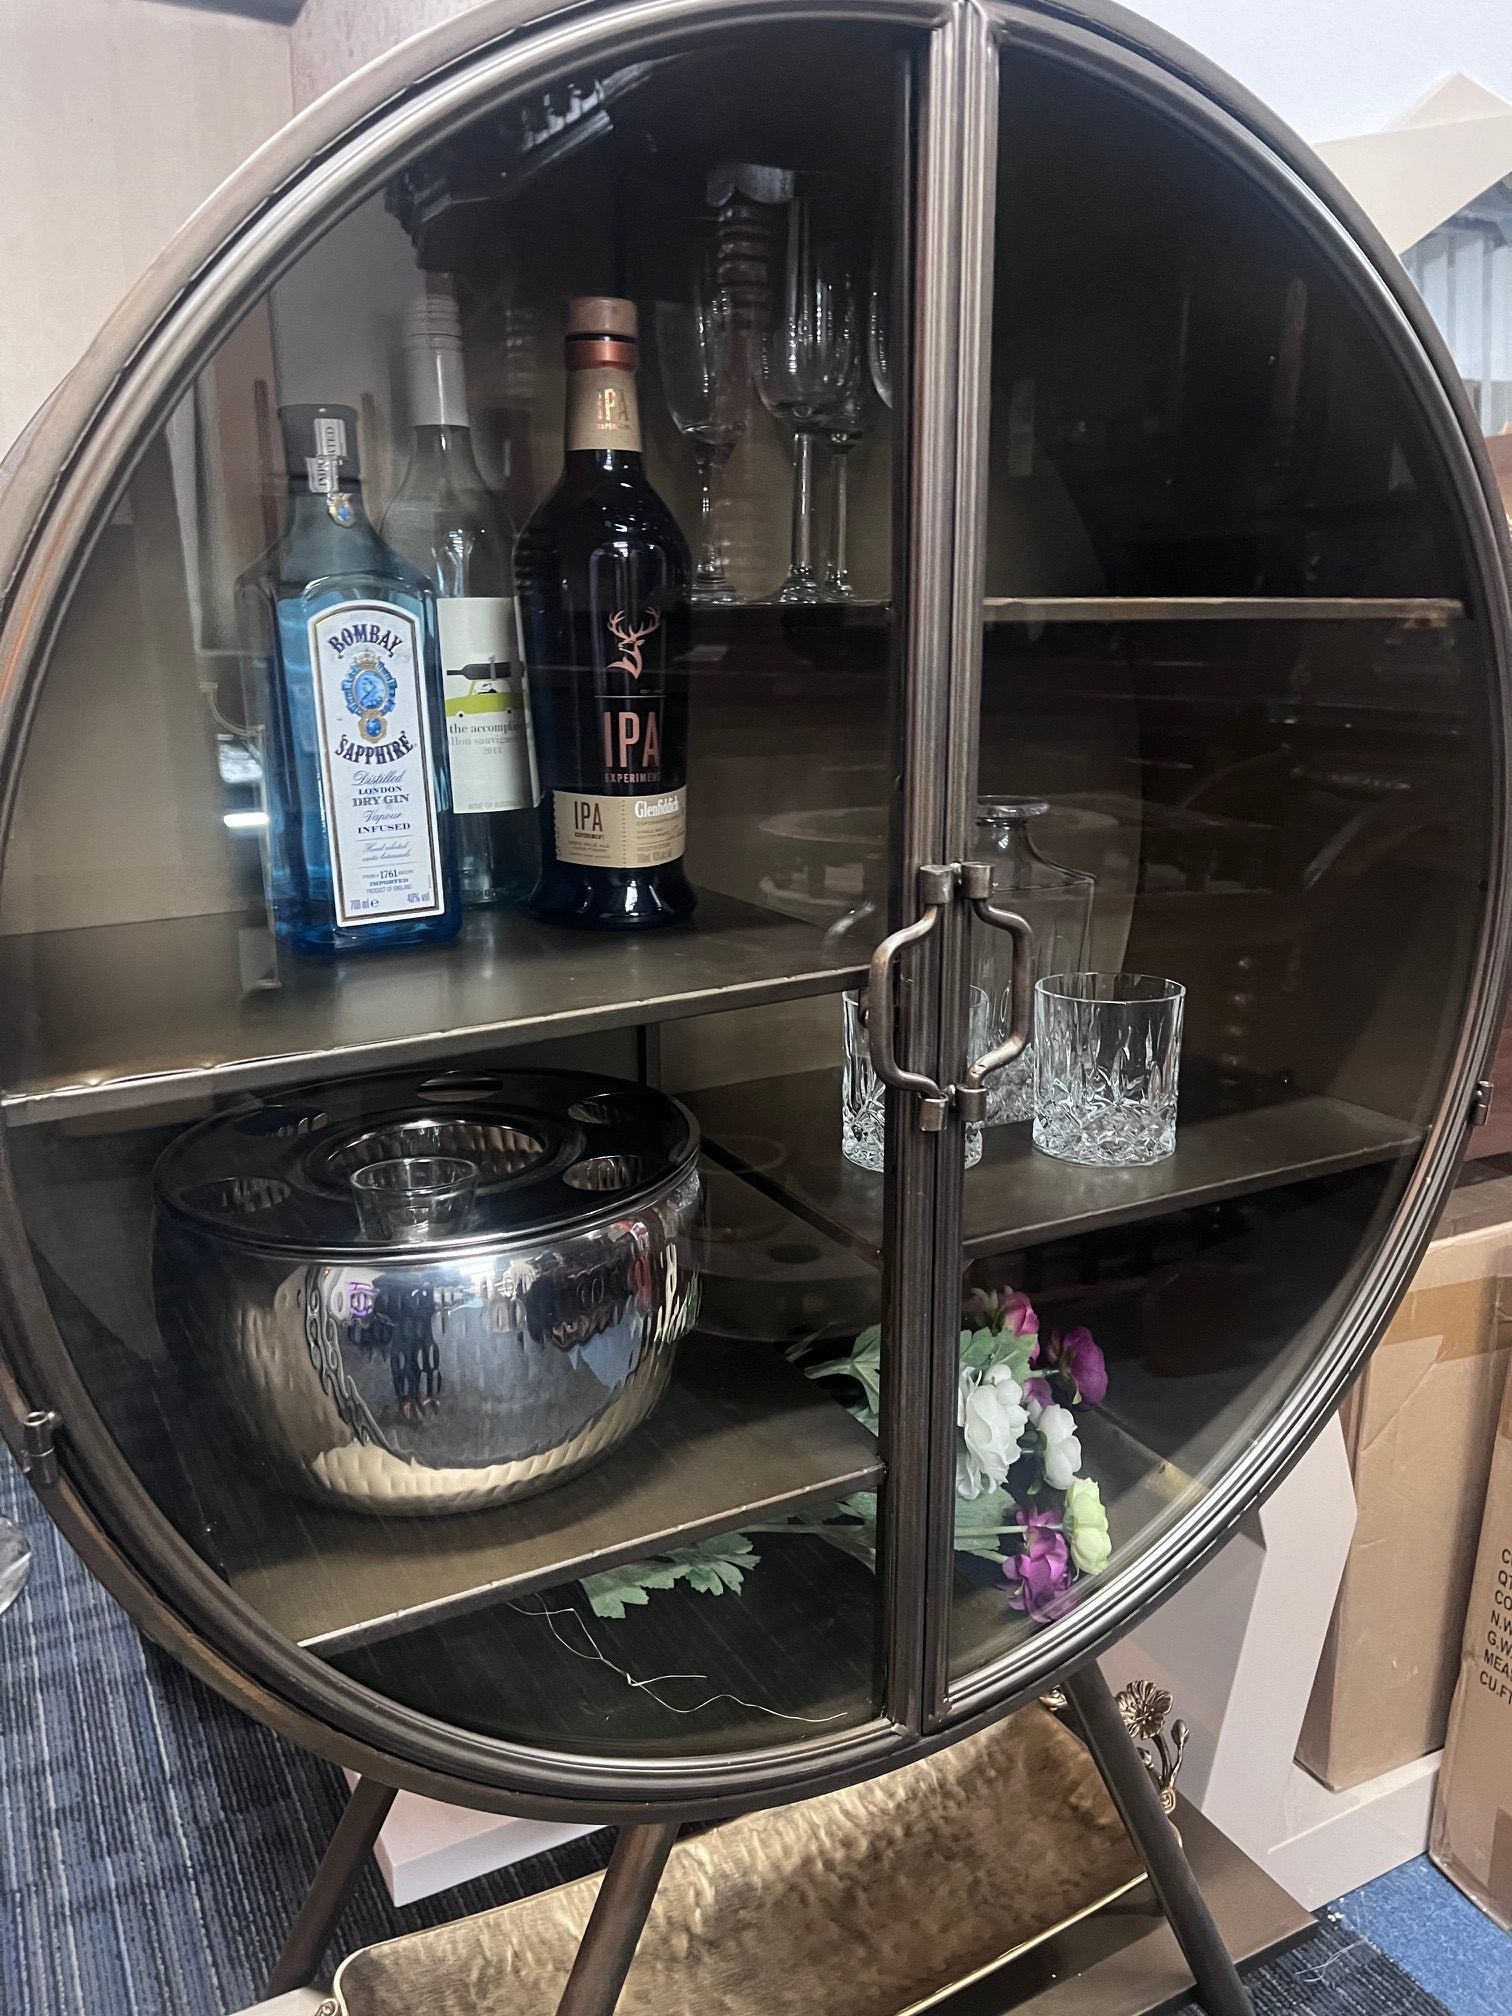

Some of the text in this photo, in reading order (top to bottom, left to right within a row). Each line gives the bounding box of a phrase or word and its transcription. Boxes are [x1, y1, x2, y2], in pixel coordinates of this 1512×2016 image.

[596, 388, 629, 421] IPA
[328, 623, 403, 659] BOMBAY
[449, 722, 468, 734] the
[603, 711, 661, 768] IPA
[335, 731, 414, 765] SAPPHIRE
[351, 769, 407, 787] Distilled
[358, 785, 403, 795] LONDON
[351, 793, 409, 807] DRY GIN
[363, 808, 403, 824] Vapour
[574, 801, 603, 832] IPA
[357, 823, 411, 834] INFUSED
[380, 869, 398, 879] 1761
[369, 878, 409, 887] IMPORTED
